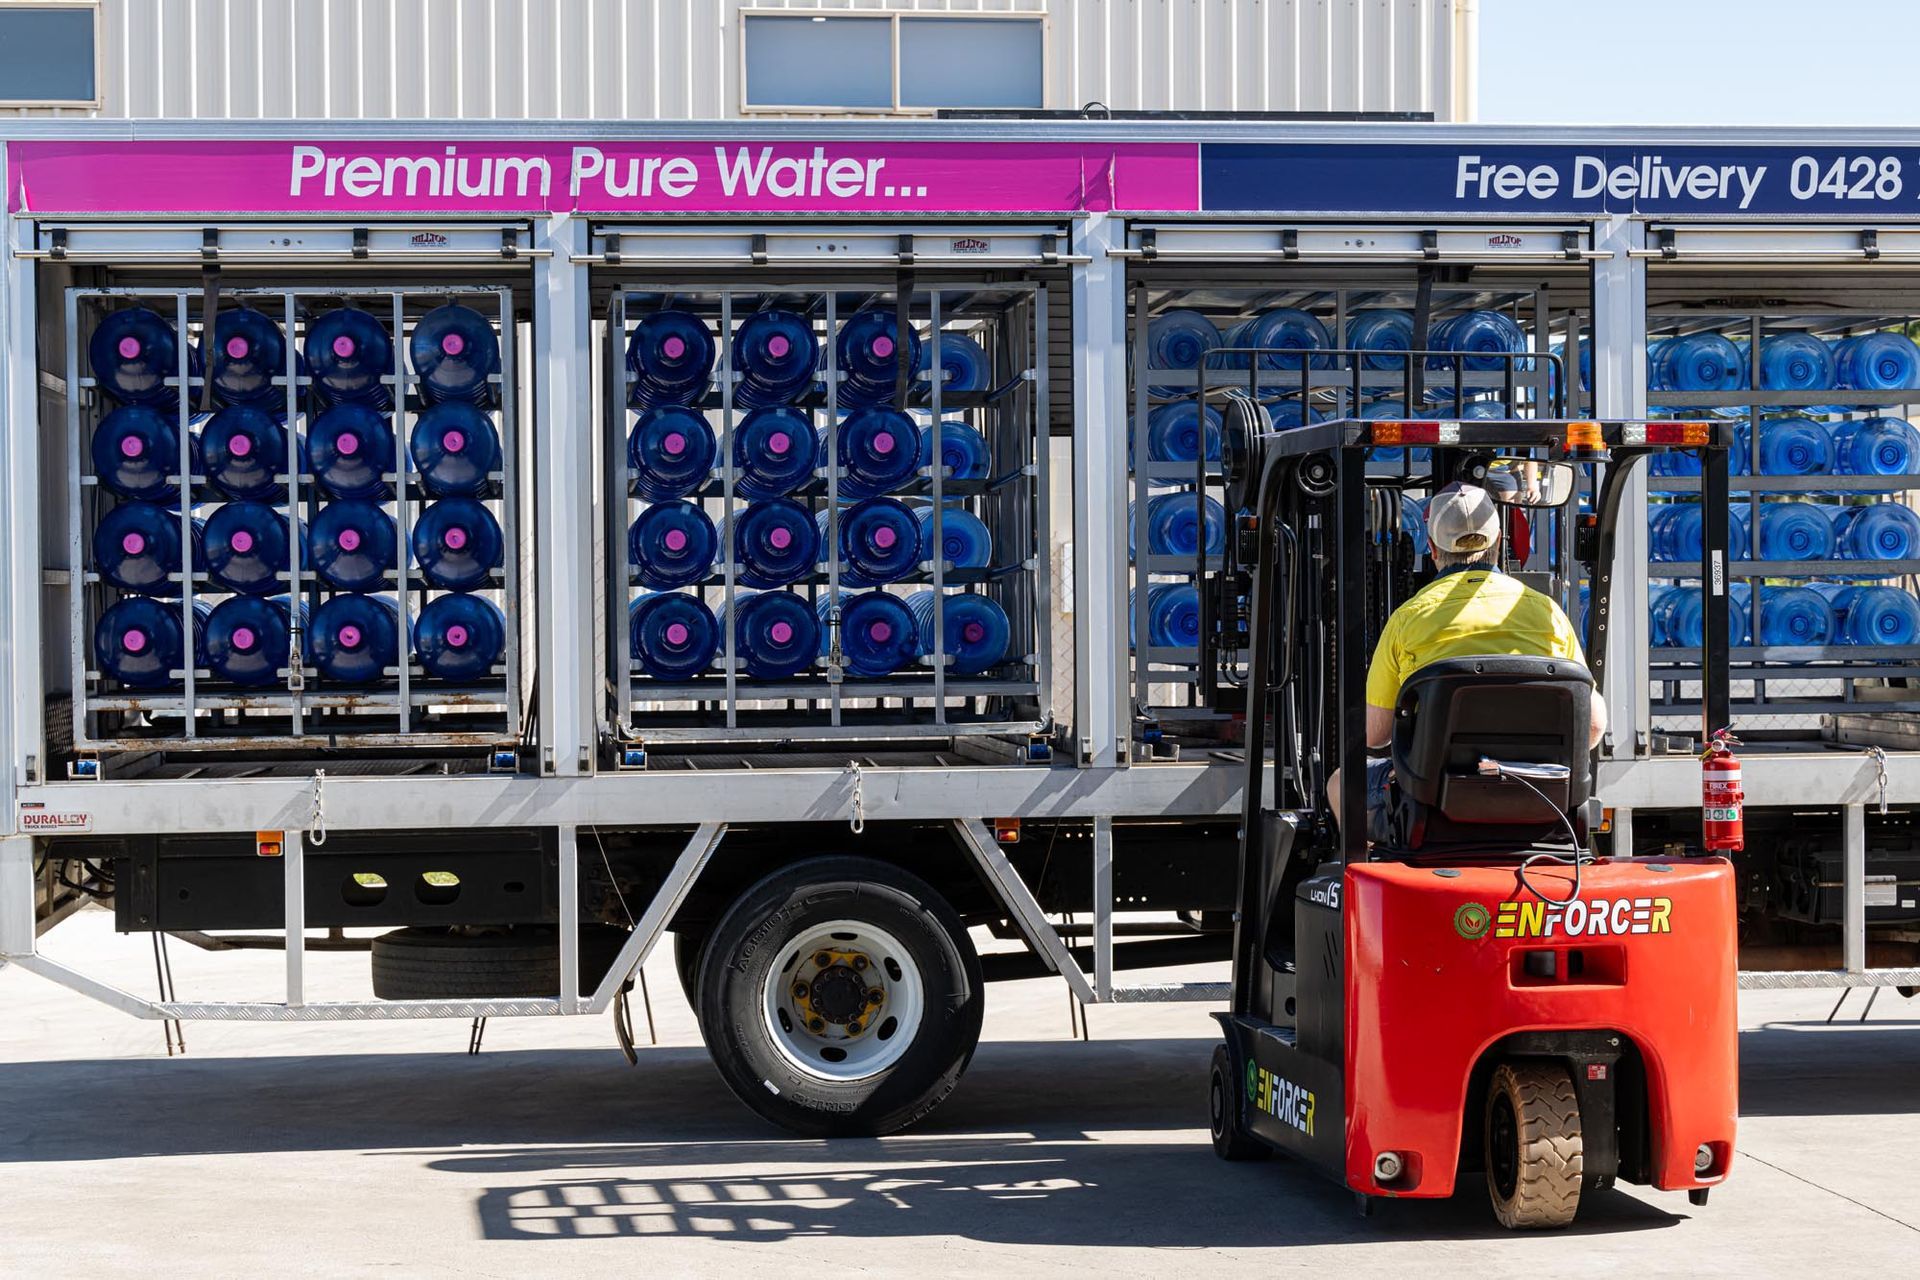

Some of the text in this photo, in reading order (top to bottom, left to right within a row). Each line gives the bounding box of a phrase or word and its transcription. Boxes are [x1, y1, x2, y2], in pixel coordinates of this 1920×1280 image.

[290, 145, 928, 198] Premium Pure Water...
[1455, 155, 1560, 200] Free
[1572, 155, 1767, 209] Delivery
[1789, 155, 1903, 200] 0428
[411, 232, 447, 242] HILLTOP
[953, 239, 988, 249] HILLTOP
[1489, 234, 1522, 245] HILLTOP
[1713, 560, 1722, 586] 36937
[23, 814, 87, 824] DURALLOY
[1495, 897, 1673, 938] ENFORCER
[1257, 1066, 1316, 1138] ENFORCER
